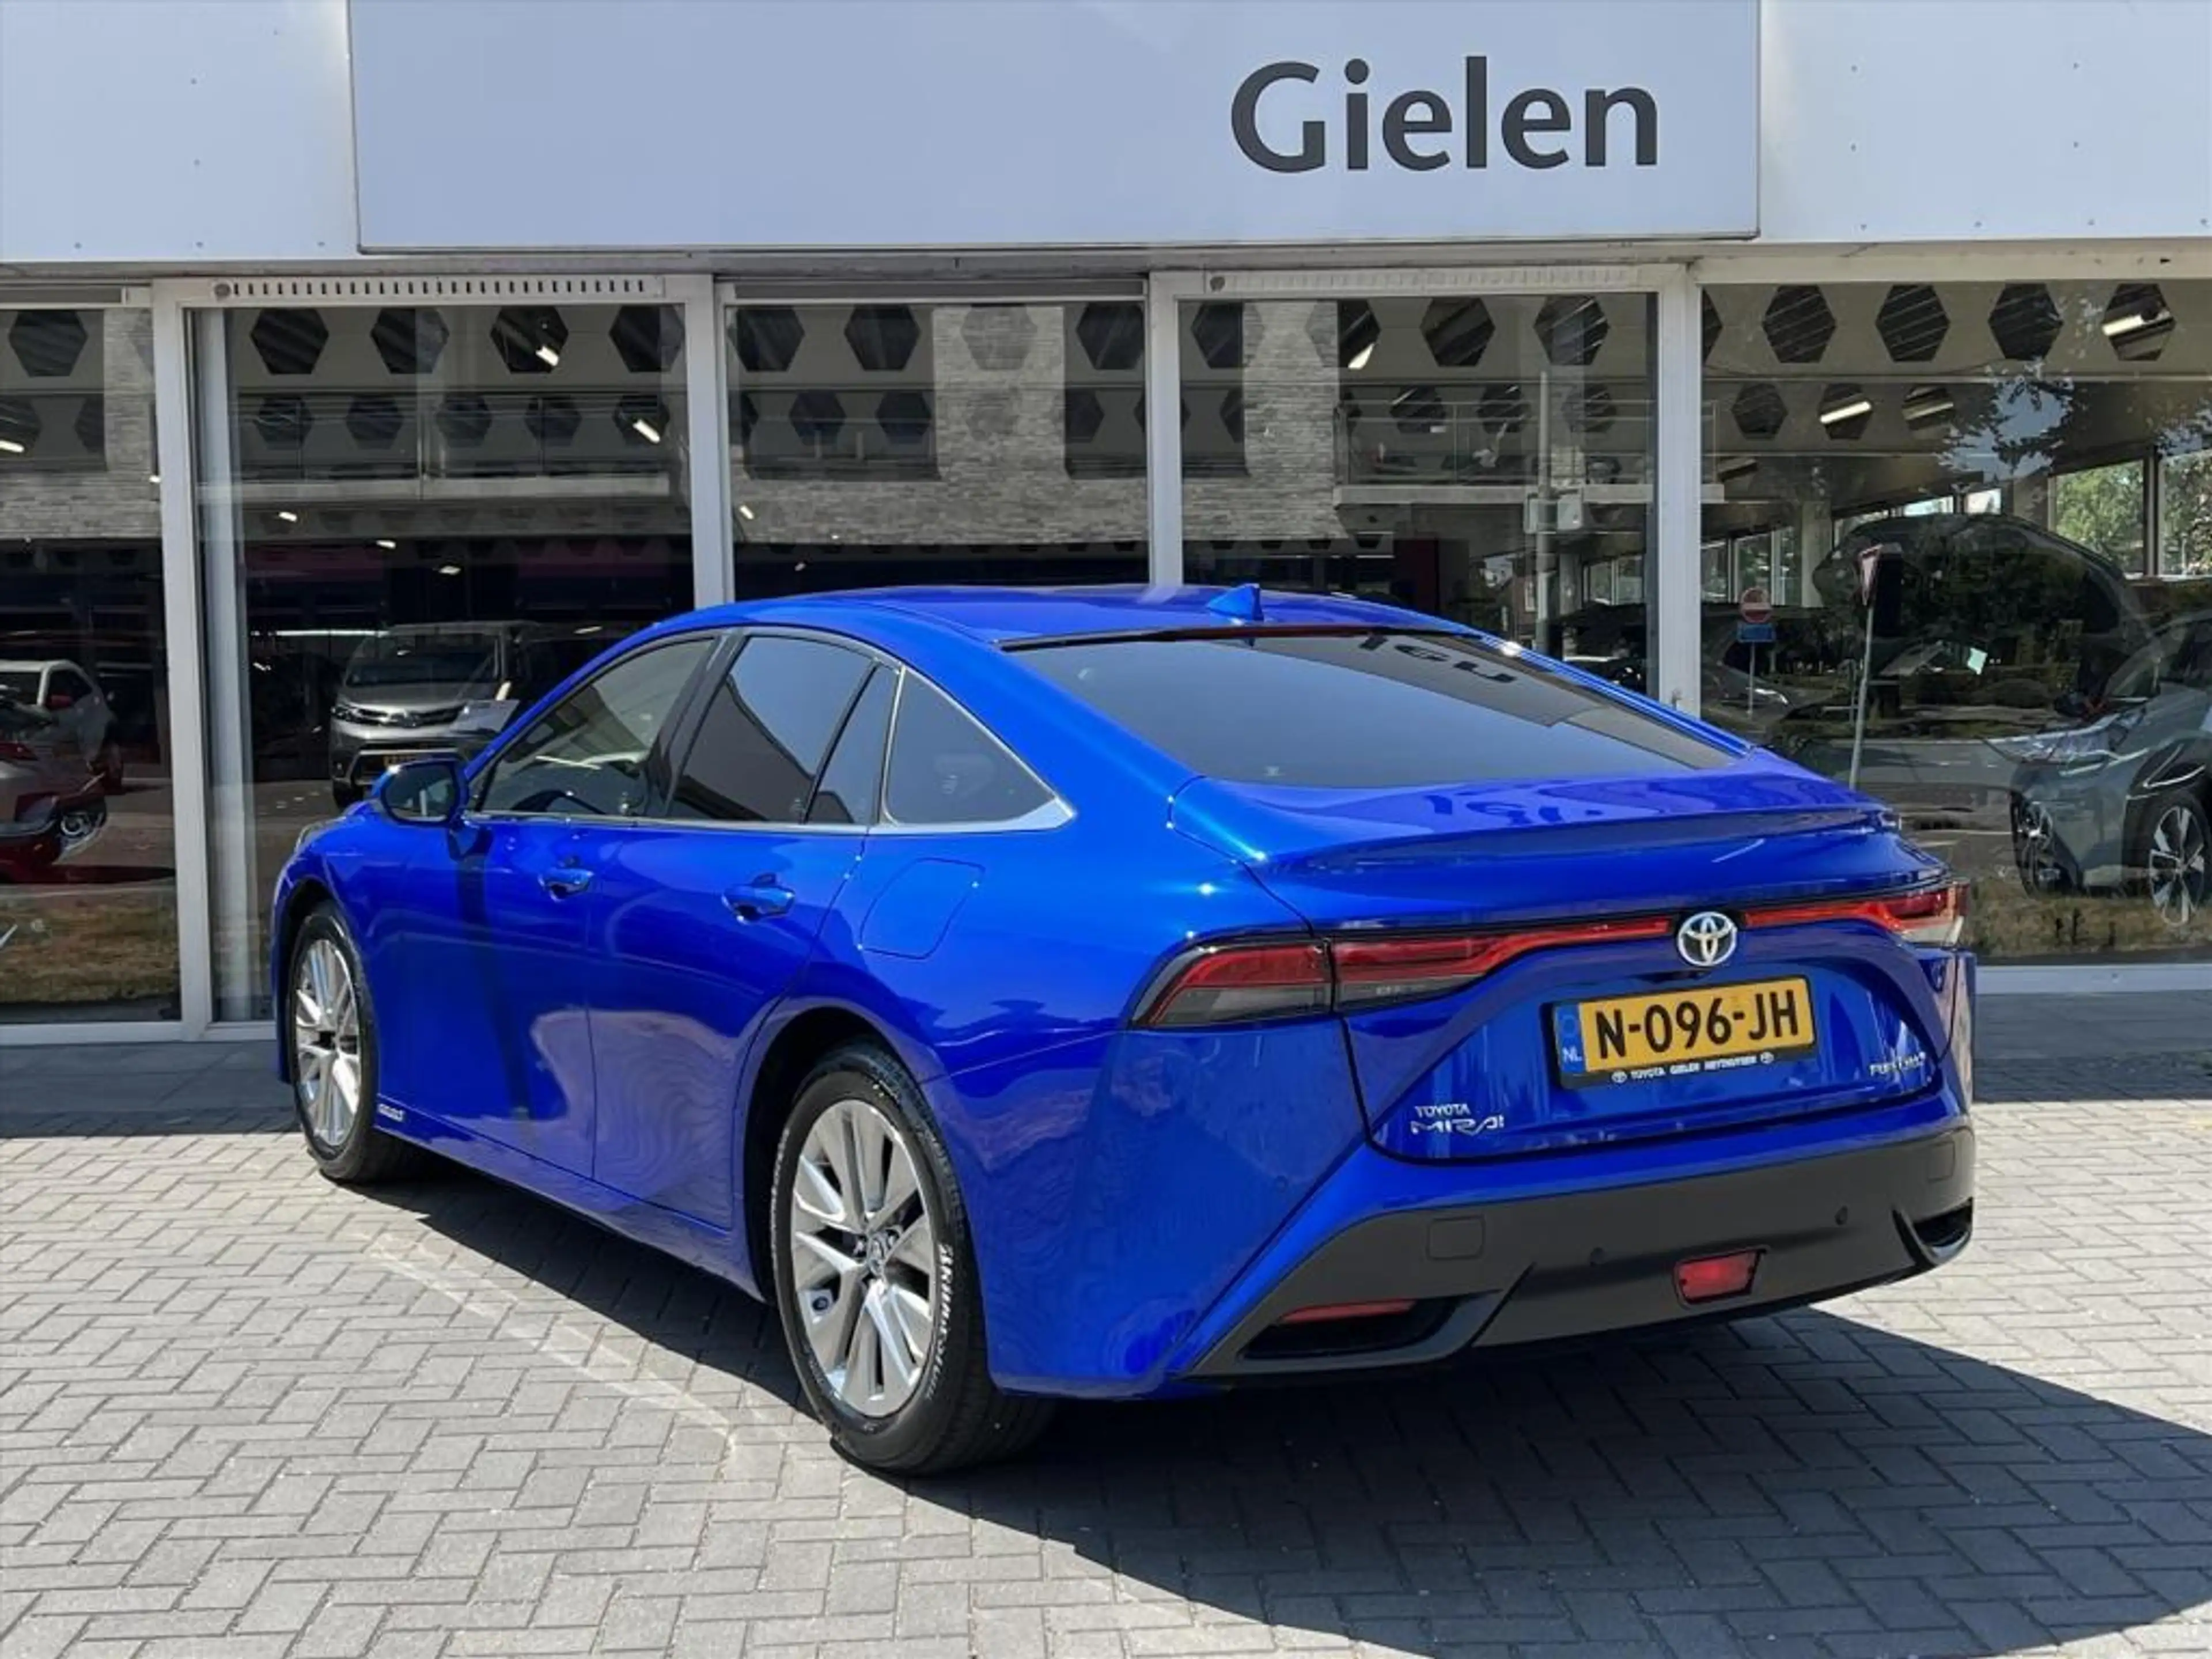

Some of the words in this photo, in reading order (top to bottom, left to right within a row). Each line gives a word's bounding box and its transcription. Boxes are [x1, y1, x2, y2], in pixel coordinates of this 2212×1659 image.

[1230, 55, 1657, 173] Gielen
[1595, 989, 1799, 1059] N-096-JH
[1562, 1046, 1583, 1063] NL
[1631, 1067, 1666, 1080] TOYOTA
[1414, 1103, 1472, 1118] TOYOTA
[1410, 1114, 1505, 1137] MIRAI
